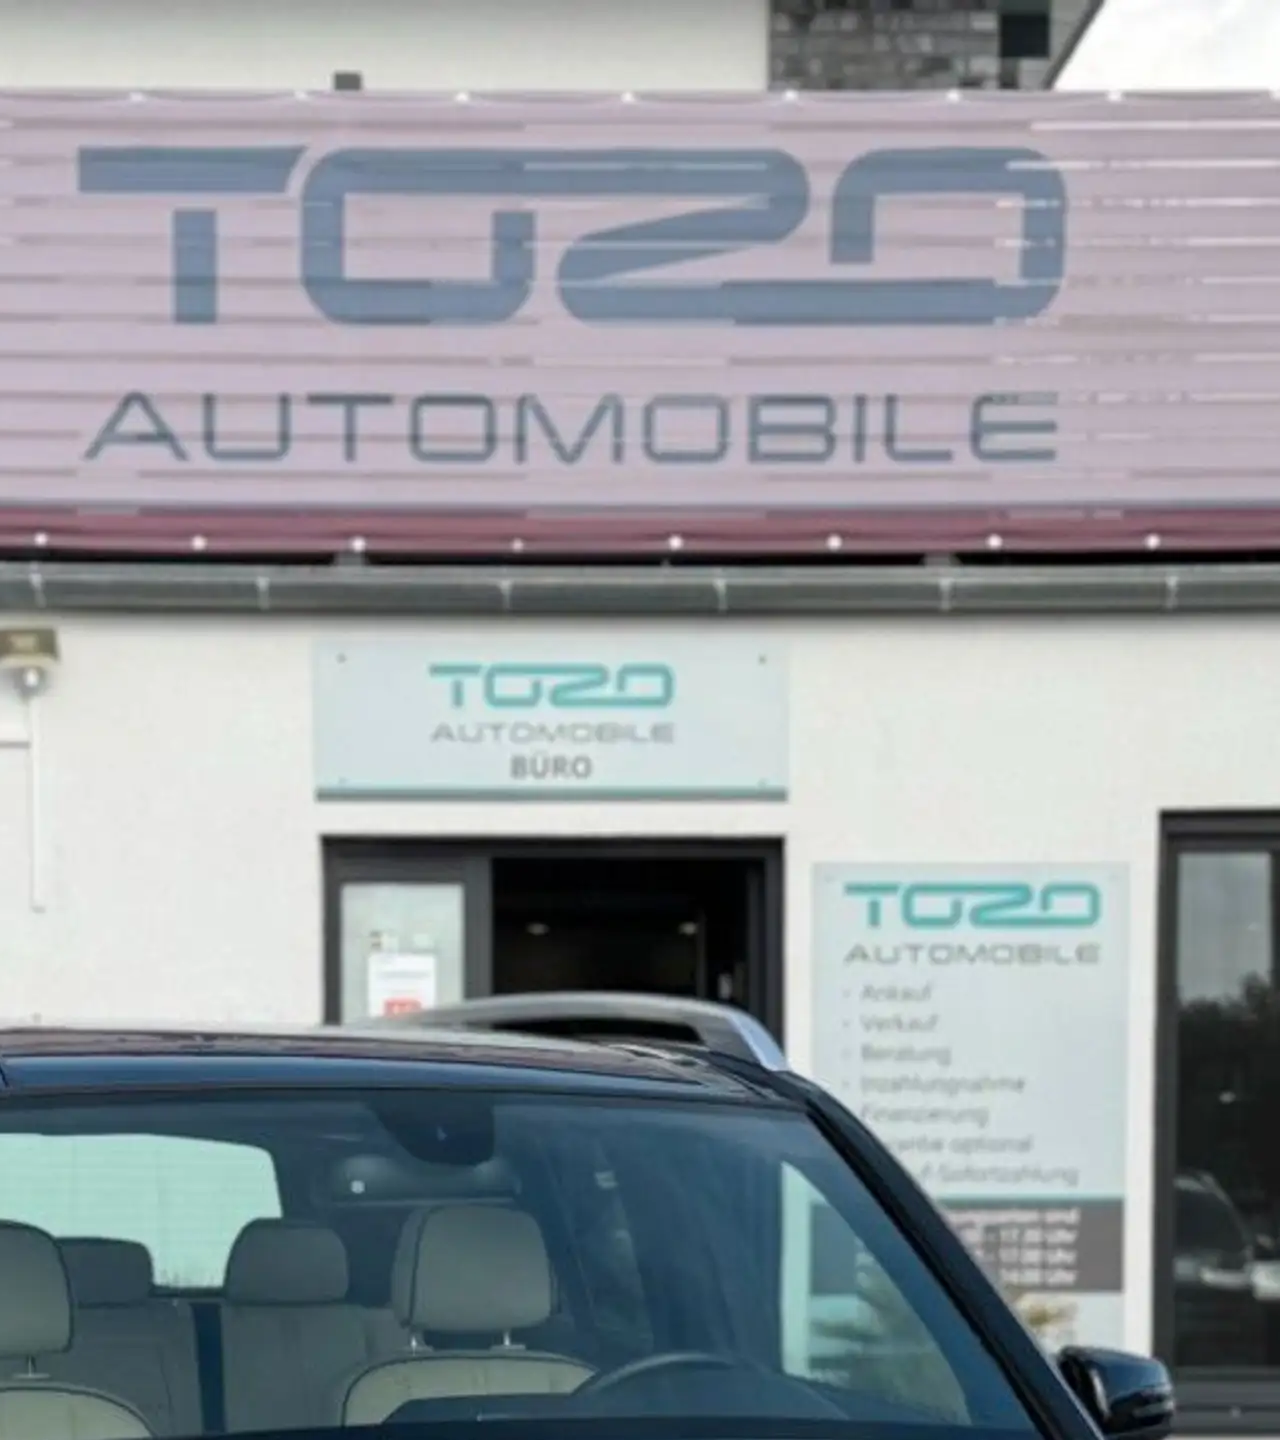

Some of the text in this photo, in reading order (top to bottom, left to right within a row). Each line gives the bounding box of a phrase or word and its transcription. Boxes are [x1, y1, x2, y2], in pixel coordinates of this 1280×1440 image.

[83, 389, 1058, 466] AUTOMOBILE
[430, 722, 676, 744] AUTOMOBILE
[510, 748, 592, 780] BÜRO
[843, 943, 1102, 966] AUTOMOBILE
